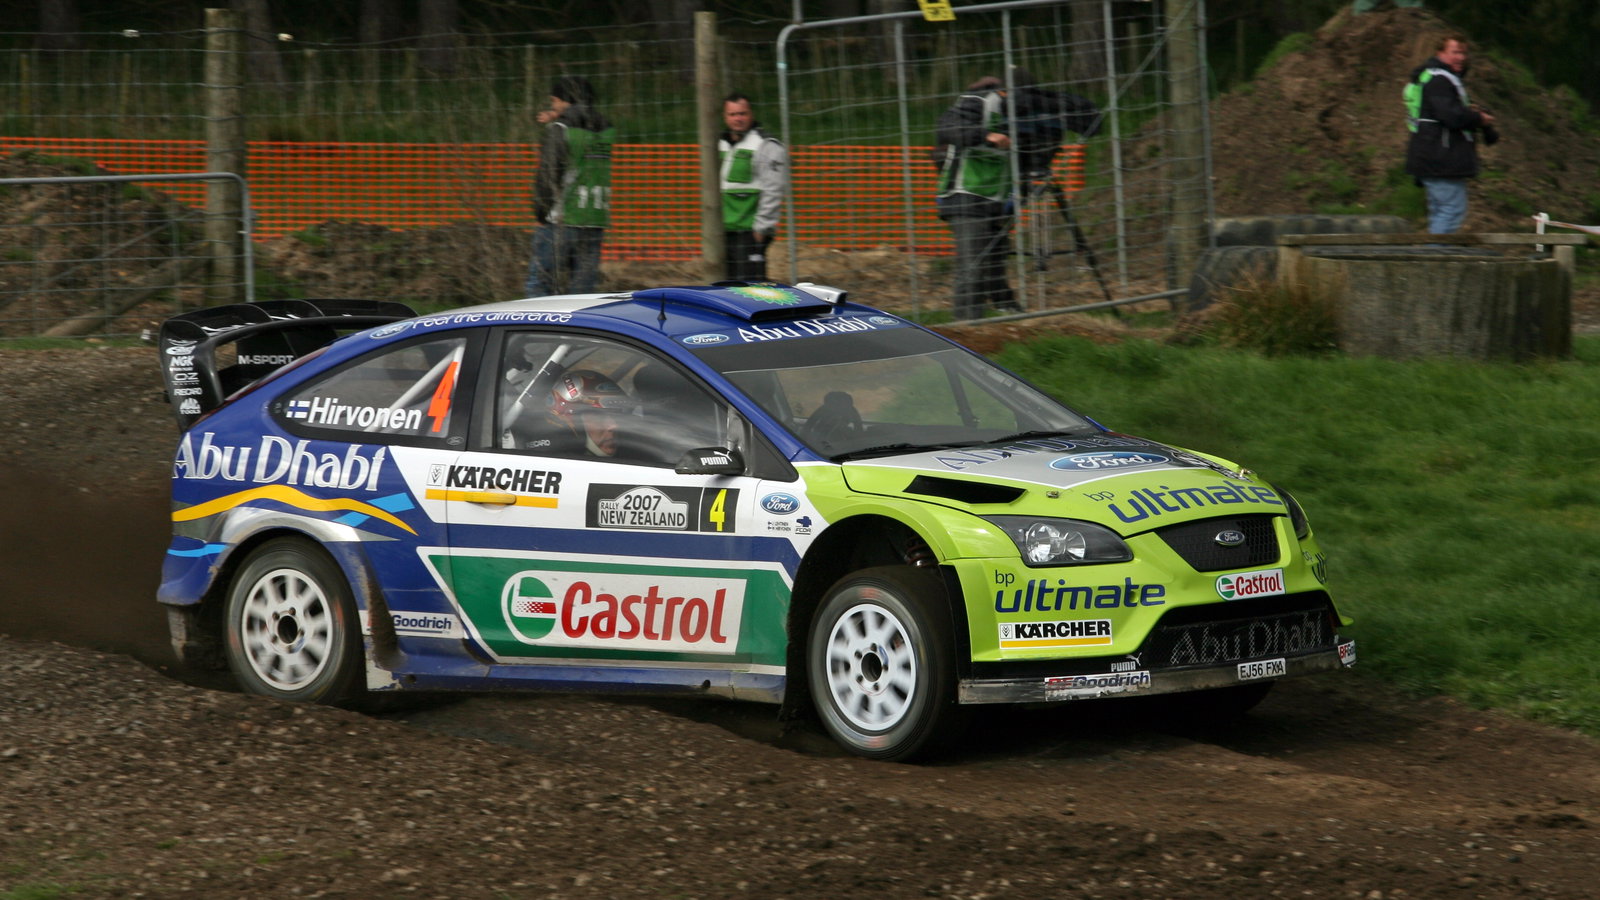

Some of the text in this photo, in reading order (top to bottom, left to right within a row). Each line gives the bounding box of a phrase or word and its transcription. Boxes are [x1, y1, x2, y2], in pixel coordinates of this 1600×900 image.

[738, 317, 877, 342] Abu Dhabi
[171, 356, 194, 367] NGK
[238, 355, 294, 365] M-SPORT
[427, 361, 459, 433] 4
[307, 397, 422, 430] Hirvonen
[172, 432, 388, 491] Abu Dhabi
[700, 456, 729, 466] PUMA
[1070, 453, 1153, 469] Ford
[446, 465, 562, 494] KÄRCHER
[600, 494, 662, 511] RALLY 2007
[1083, 489, 1115, 502] bp
[1107, 480, 1282, 524] ultimate
[600, 510, 685, 527] NEW ZEALAND
[709, 489, 728, 532] 4
[995, 570, 1014, 587] bp
[1235, 572, 1282, 596] Castrol
[995, 577, 1165, 613] ultimate
[561, 581, 726, 643] Castrol
[1015, 620, 1110, 638] KÄRCHER
[1170, 612, 1322, 664] Abu Dhabi
[1111, 661, 1136, 672] PUMA
[1240, 662, 1284, 679] EJ56 FXA
